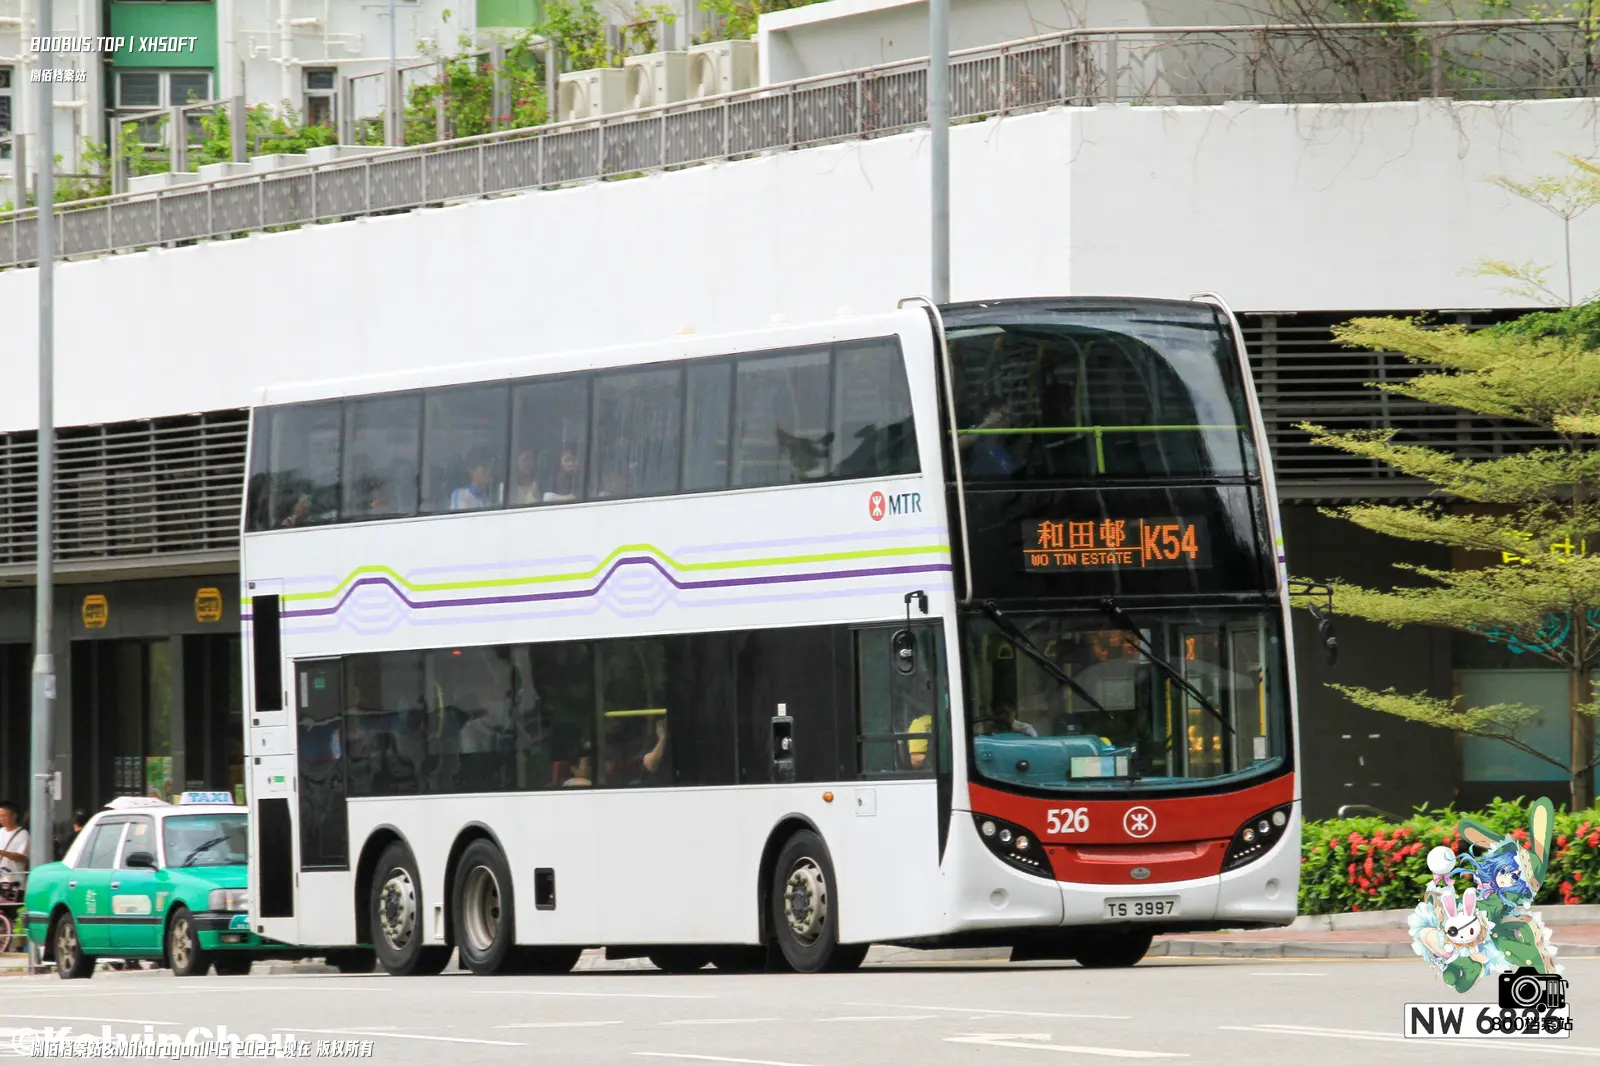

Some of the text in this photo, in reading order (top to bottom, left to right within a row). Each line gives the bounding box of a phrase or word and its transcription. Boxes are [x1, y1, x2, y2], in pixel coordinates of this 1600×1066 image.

[889, 492, 922, 515] MTR
[1036, 518, 1127, 549] 和田邨
[1144, 524, 1199, 560] K54
[1031, 552, 1133, 566] WO TIN ESTATE
[188, 792, 229, 803] TAXI
[1047, 807, 1090, 834] 526
[1108, 900, 1175, 917] TS 3997
